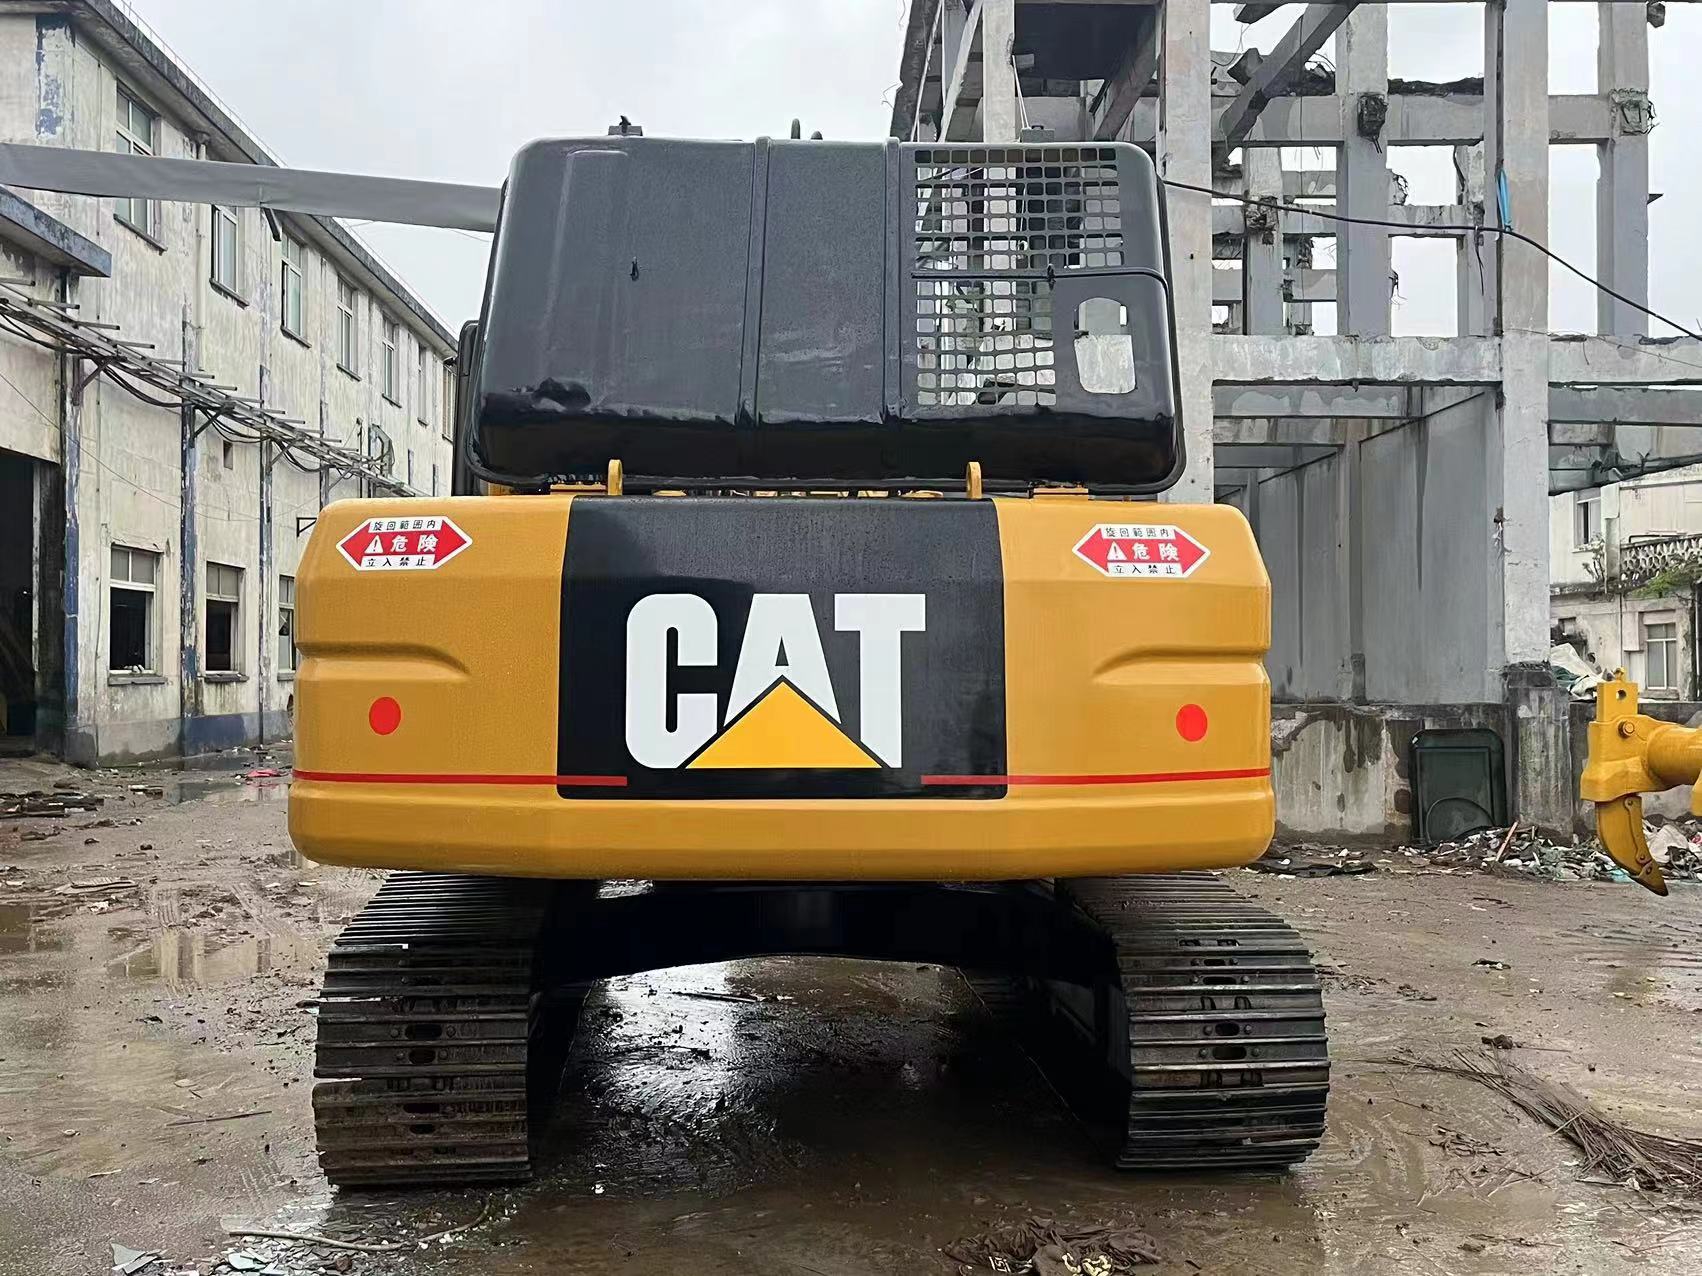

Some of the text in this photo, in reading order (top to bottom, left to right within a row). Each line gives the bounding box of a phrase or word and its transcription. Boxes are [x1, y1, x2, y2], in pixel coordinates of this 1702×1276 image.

[391, 534, 439, 553] 危険
[1132, 542, 1180, 561] 危険
[366, 556, 427, 567] 立入禁止
[1115, 564, 1176, 574] 立入禁止
[625, 593, 926, 769] CAT
